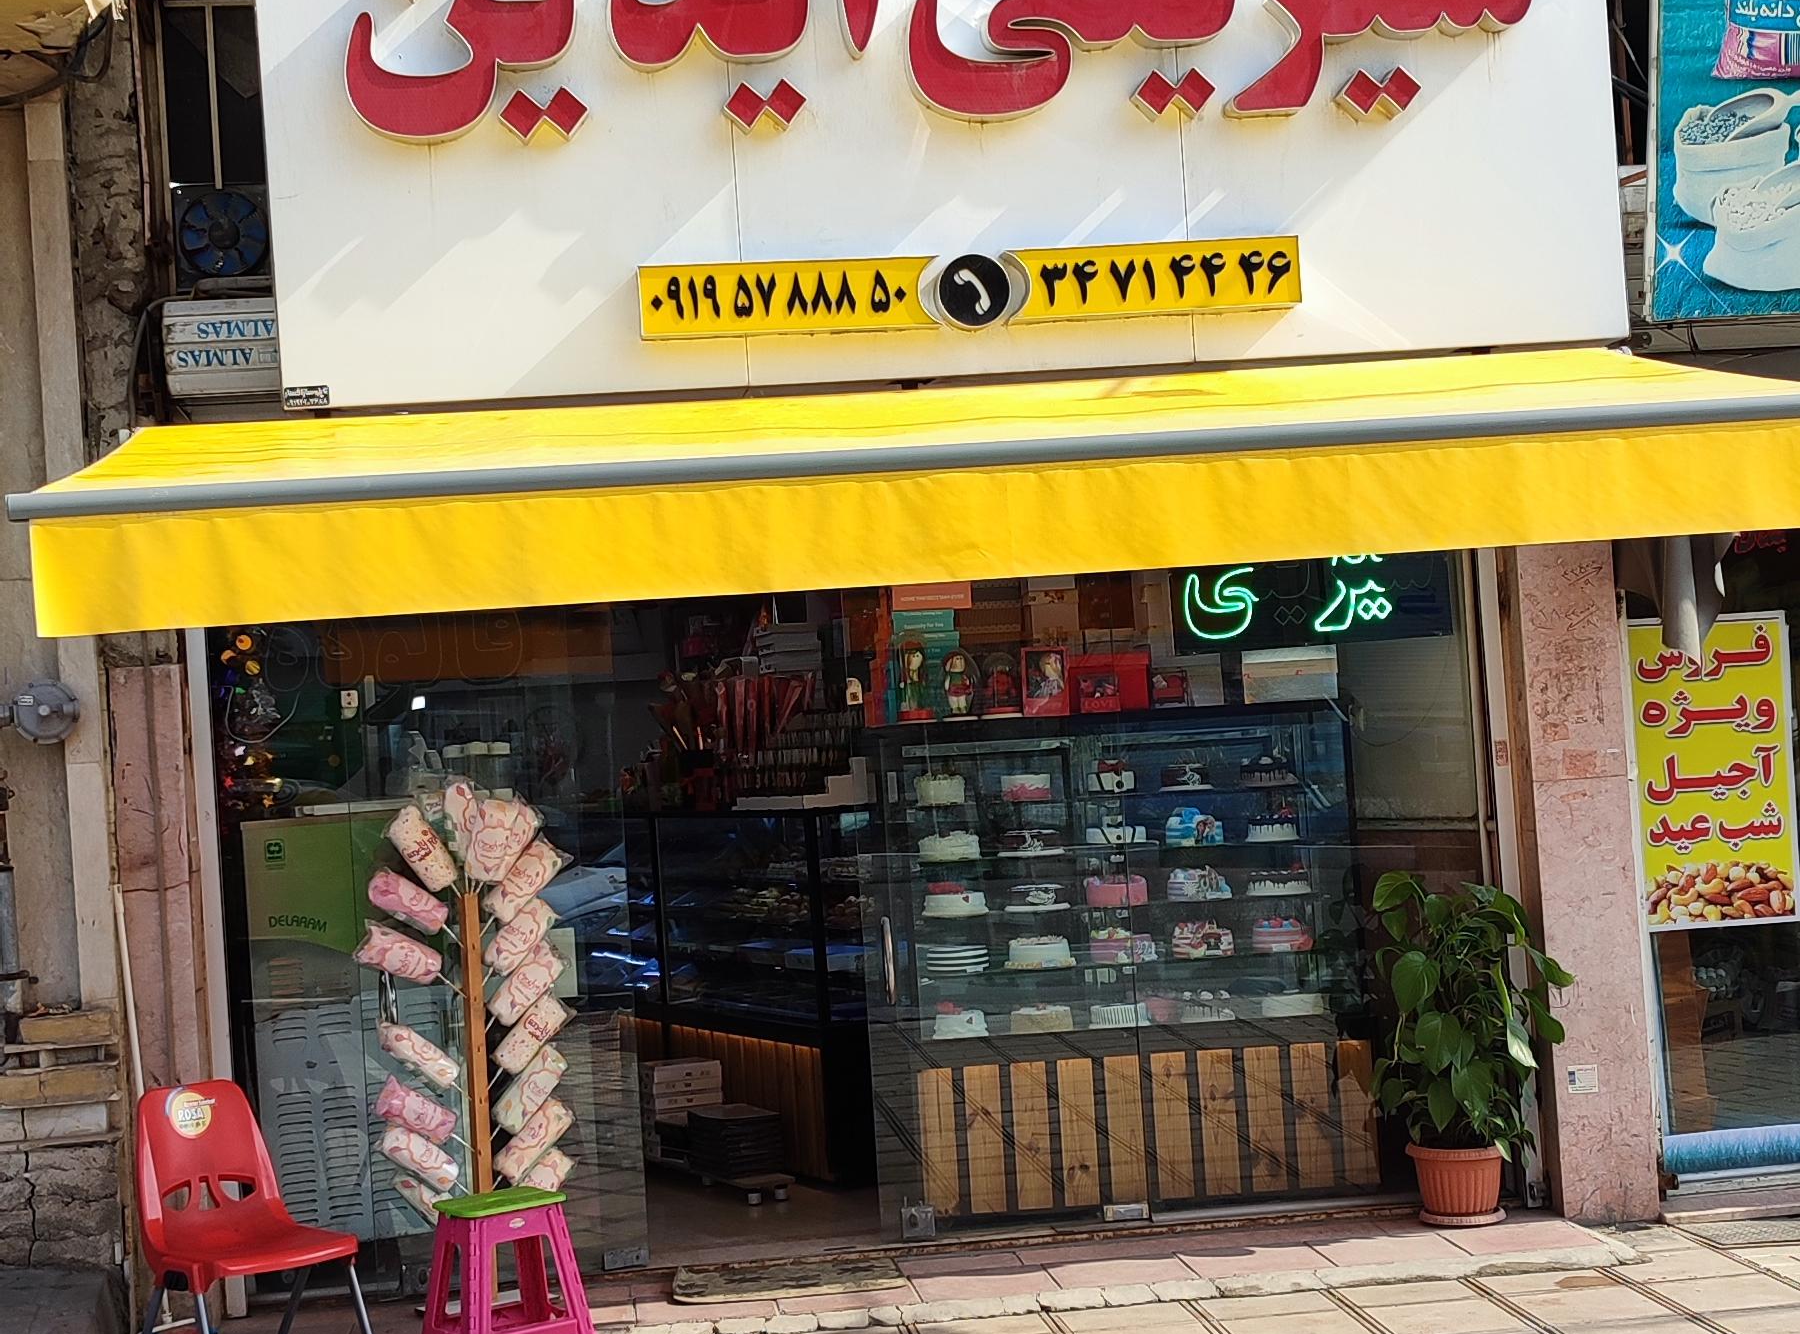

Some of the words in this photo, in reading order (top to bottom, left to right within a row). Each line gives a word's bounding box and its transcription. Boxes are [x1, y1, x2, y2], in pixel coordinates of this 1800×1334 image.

[1760, 0, 1795, 18] دانه
[650, 274, 721, 320] ۰۹۱۹
[733, 273, 777, 318] ۵۷
[786, 269, 857, 316] ۸۸۸
[1039, 259, 1099, 308] ۳۴
[1109, 258, 1156, 303] ۷۱
[1168, 252, 1227, 299] ۴۴
[1238, 250, 1292, 296] ۴۶
[196, 319, 275, 340] ALMAS
[176, 348, 255, 368] ALMAS
[1640, 690, 1777, 738] ویژه
[1646, 744, 1780, 803] آجیل
[1648, 813, 1712, 853] عید
[1719, 802, 1784, 850] شب
[268, 914, 328, 933] DELARAM
[178, 1107, 205, 1122] ROSA
